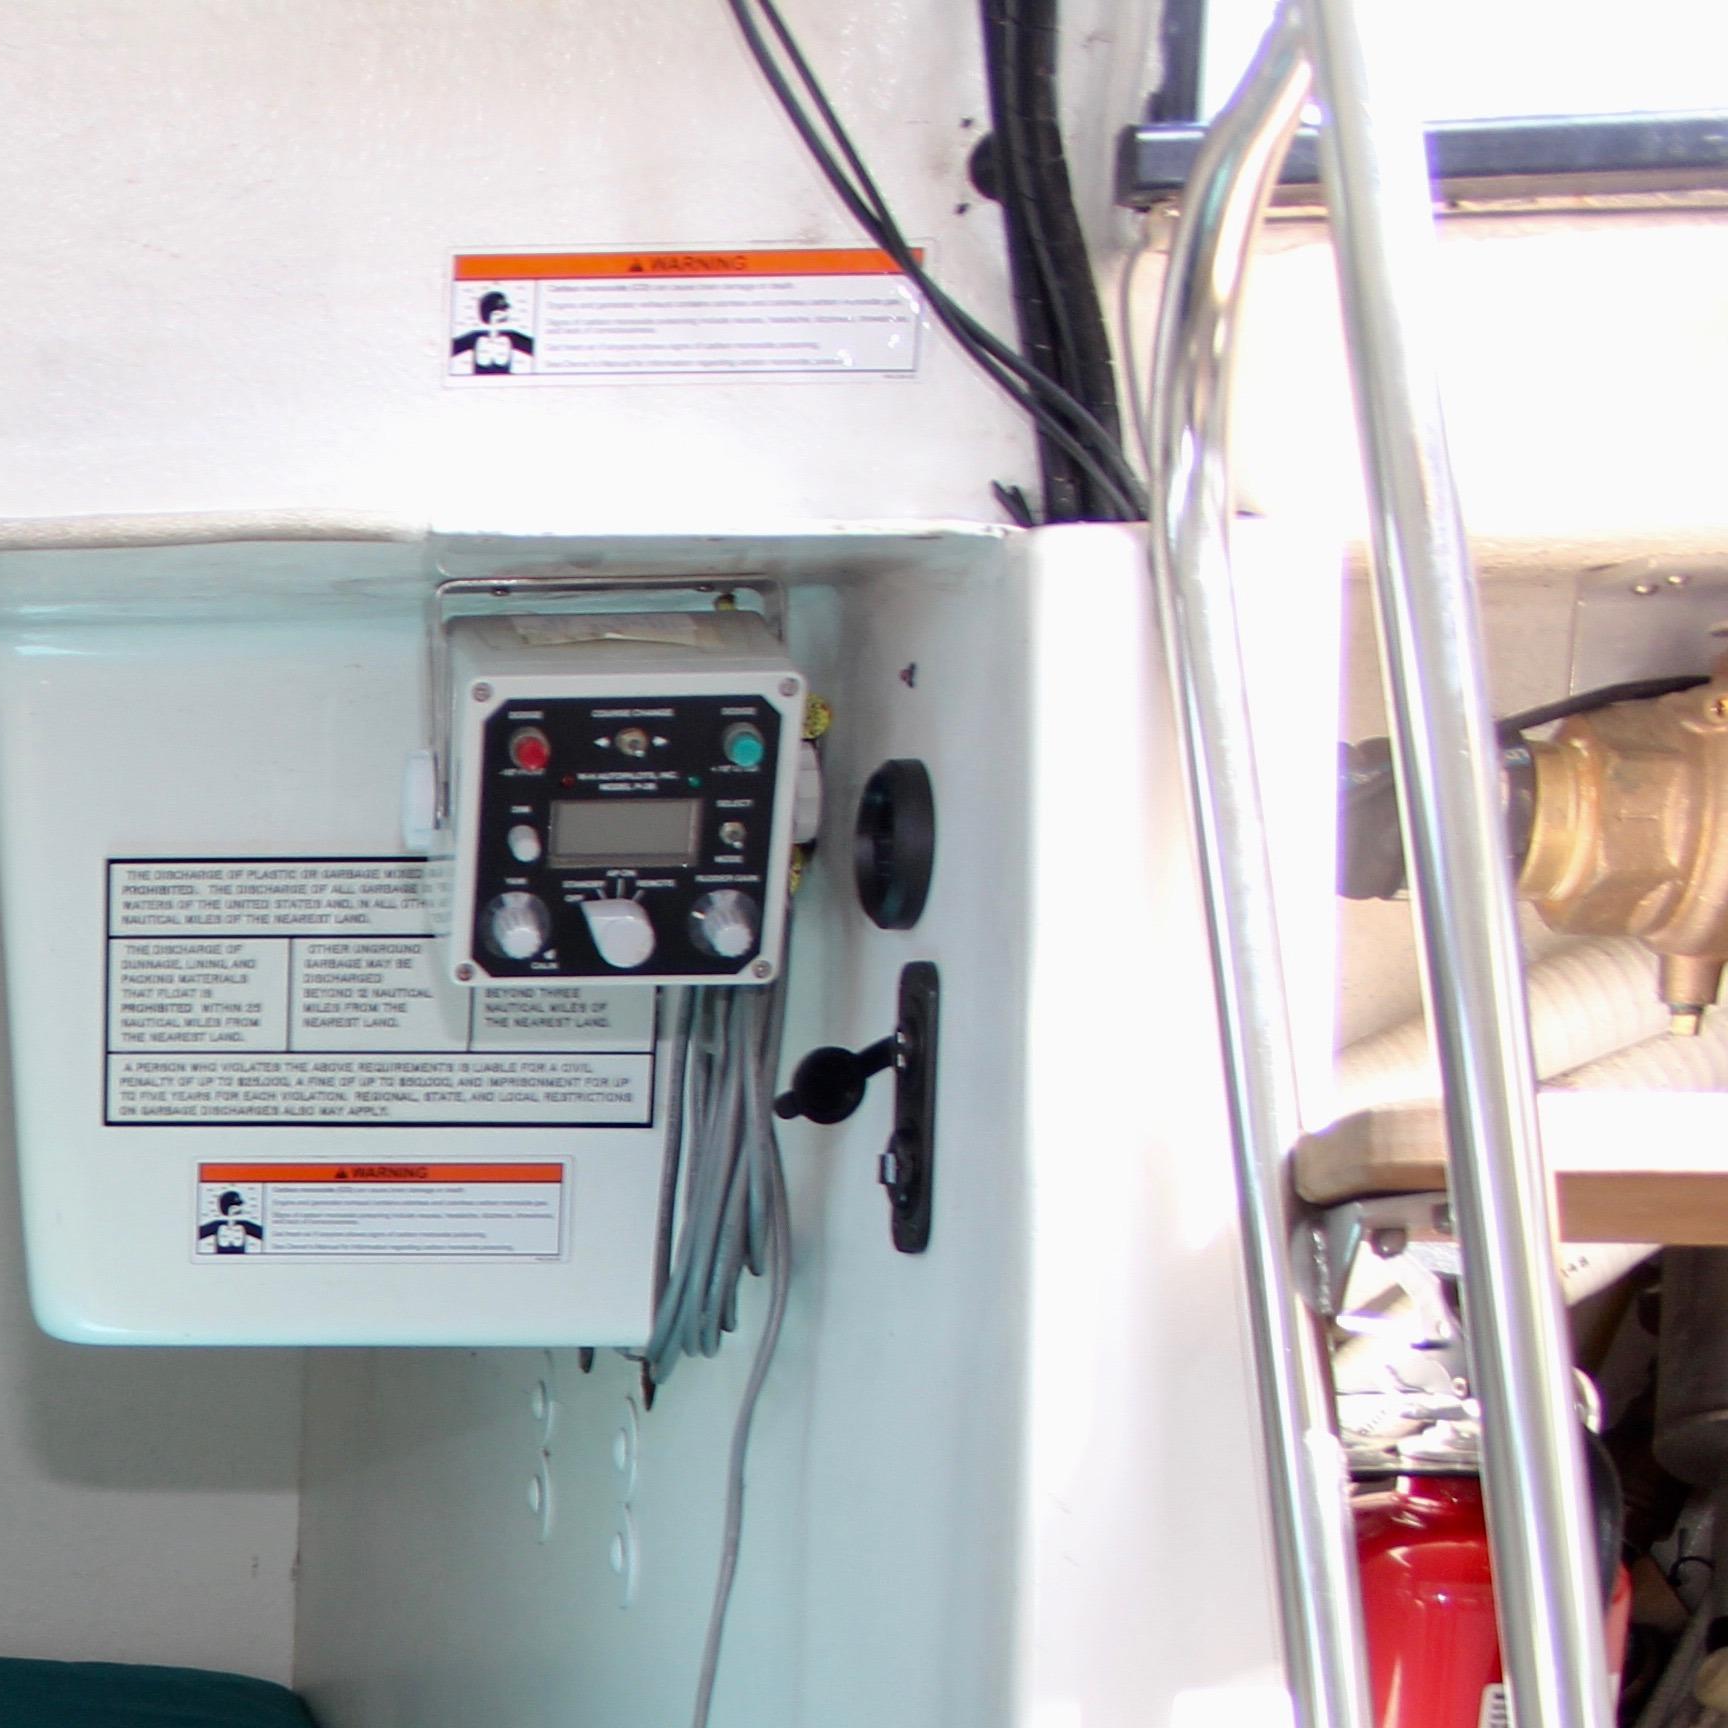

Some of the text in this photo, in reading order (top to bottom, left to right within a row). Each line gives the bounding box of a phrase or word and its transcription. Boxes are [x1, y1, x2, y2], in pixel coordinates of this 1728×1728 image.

[650, 255, 747, 271] WARNING
[126, 870, 151, 880] THE
[155, 870, 223, 880] DISCHARGE
[247, 870, 296, 880] PLASTIC
[321, 869, 380, 879] GARBAGE
[383, 869, 423, 879] MIXED
[122, 885, 198, 895] PROHIBITED.
[208, 885, 232, 895] THE
[236, 885, 307, 895] DISCHARGE
[330, 884, 355, 894] ALL
[359, 884, 417, 894] GARBAGE
[123, 900, 173, 910] WATERS
[197, 900, 220, 910] THE
[225, 900, 269, 910] UNITED
[274, 900, 321, 910] STATES
[374, 899, 396, 909] ALL
[122, 914, 182, 924] NAUTICAL
[185, 914, 221, 924] MILES
[245, 914, 269, 924] THE
[274, 914, 331, 924] NEAREST
[335, 914, 370, 924] LAND.
[126, 944, 149, 954] THE
[153, 944, 223, 954] DISCHARGE
[308, 944, 421, 954] OTHER UNGROUND
[231, 960, 256, 970] AND
[304, 959, 361, 969] GARBAGE
[366, 959, 392, 969] MAY
[121, 974, 248, 984] PACKING MATERIALS
[304, 974, 382, 983] DISCHARGED
[122, 988, 154, 998] THAT
[157, 988, 196, 998] FLOAT
[304, 988, 352, 998] BEYOND
[372, 988, 434, 998] NAUTICAL
[485, 988, 580, 998] BEYOND THREE
[121, 1003, 192, 1013] PROHIBITED
[201, 1003, 242, 1013] WITHIN
[304, 1003, 407, 1013] MILES FROM THE
[485, 1003, 544, 1013] NAUTICAL
[550, 1003, 586, 1013] MILES
[121, 1018, 260, 1027] NAUTICAL MILES FROM
[304, 1018, 360, 1028] NEAREST
[485, 1017, 508, 1027] THE
[513, 1017, 572, 1027] NEAREST
[121, 1032, 145, 1042] THE
[150, 1032, 206, 1042] NEAREST
[136, 1063, 186, 1072] PERSON
[190, 1063, 216, 1072] WHO
[222, 1063, 280, 1072] VIOLATES
[284, 1063, 308, 1072] THE
[312, 1063, 352, 1072] ABOVE
[358, 1063, 453, 1072] REQUIREMENTS
[473, 1063, 516, 1072] LIABLE
[520, 1063, 543, 1072] FOR
[561, 1063, 592, 1072] CIVIL
[120, 1077, 174, 1087] PENALTY
[307, 1077, 335, 1087] FINE
[457, 1077, 482, 1087] AND
[489, 1077, 581, 1087] IMPRISONMENT
[584, 1077, 608, 1087] FOR
[140, 1092, 166, 1102] FIVE
[171, 1092, 210, 1102] YEARS
[215, 1092, 239, 1102] FOR
[244, 1092, 275, 1102] EACH
[471, 1092, 494, 1102] AND
[499, 1092, 539, 1102] LOCAL
[544, 1092, 633, 1102] RESTRICTIONS
[140, 1106, 196, 1116] GARBAGE
[200, 1106, 278, 1116] DISCHARGES
[283, 1106, 314, 1116] ALSO
[319, 1106, 344, 1116] MAY
[352, 1166, 428, 1178] WARNING
